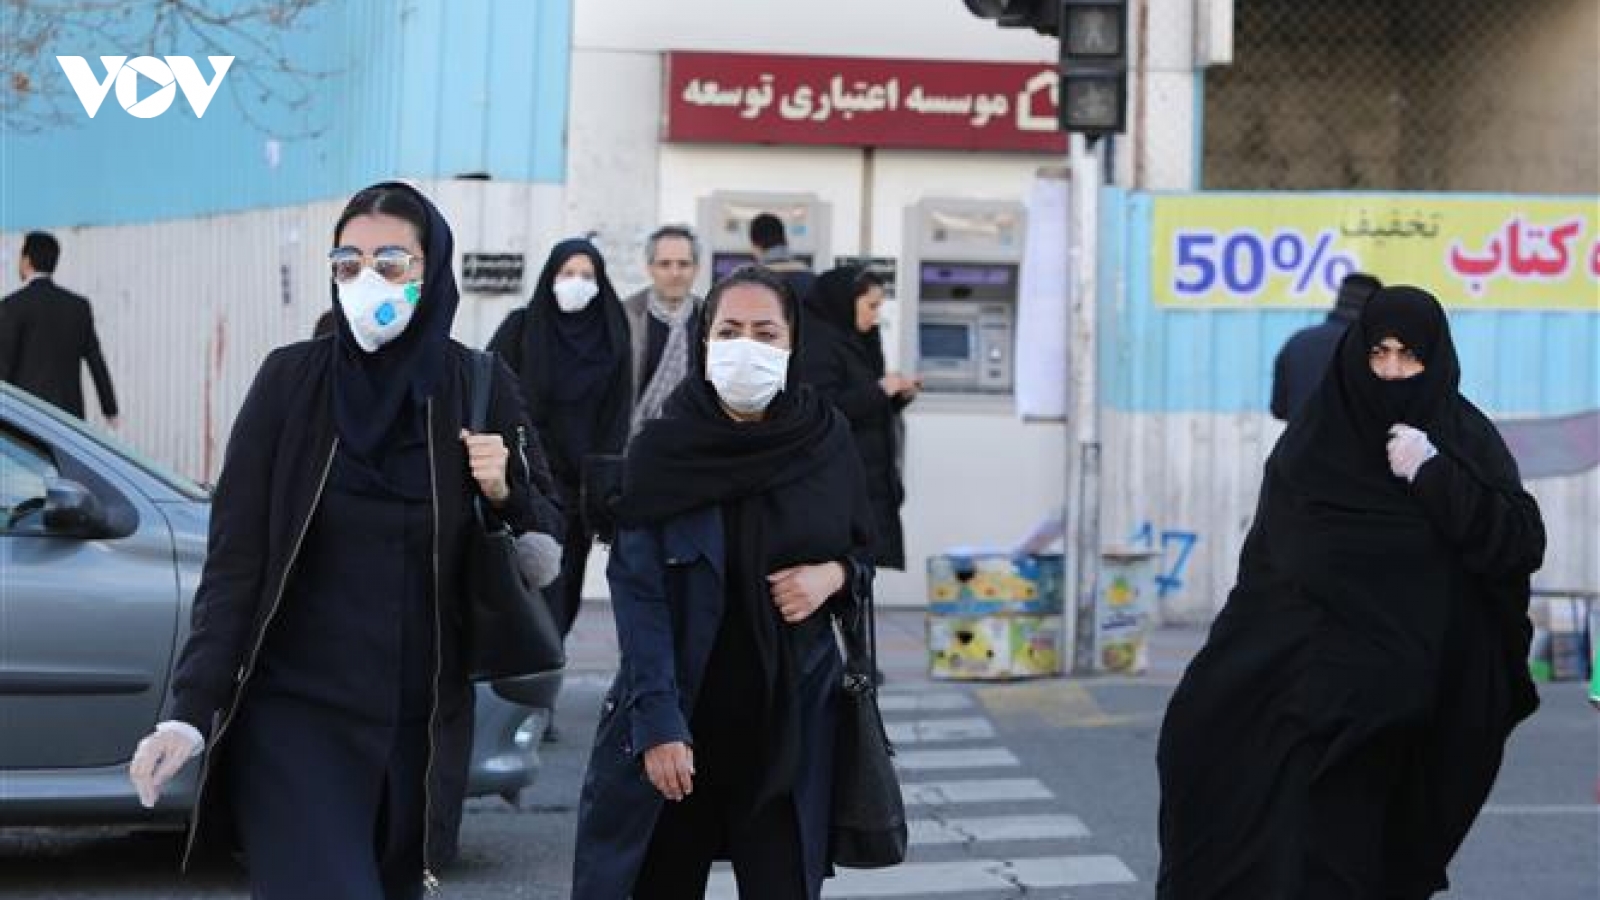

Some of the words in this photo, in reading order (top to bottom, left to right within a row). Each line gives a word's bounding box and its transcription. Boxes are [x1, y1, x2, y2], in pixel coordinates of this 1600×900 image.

[682, 74, 775, 117] توسعه
[779, 74, 899, 120] اعتباری
[906, 86, 1008, 126] موسسه
[1341, 210, 1441, 246] تخفیف
[1175, 232, 1356, 295] 50%
[1451, 219, 1579, 291] کتاب
